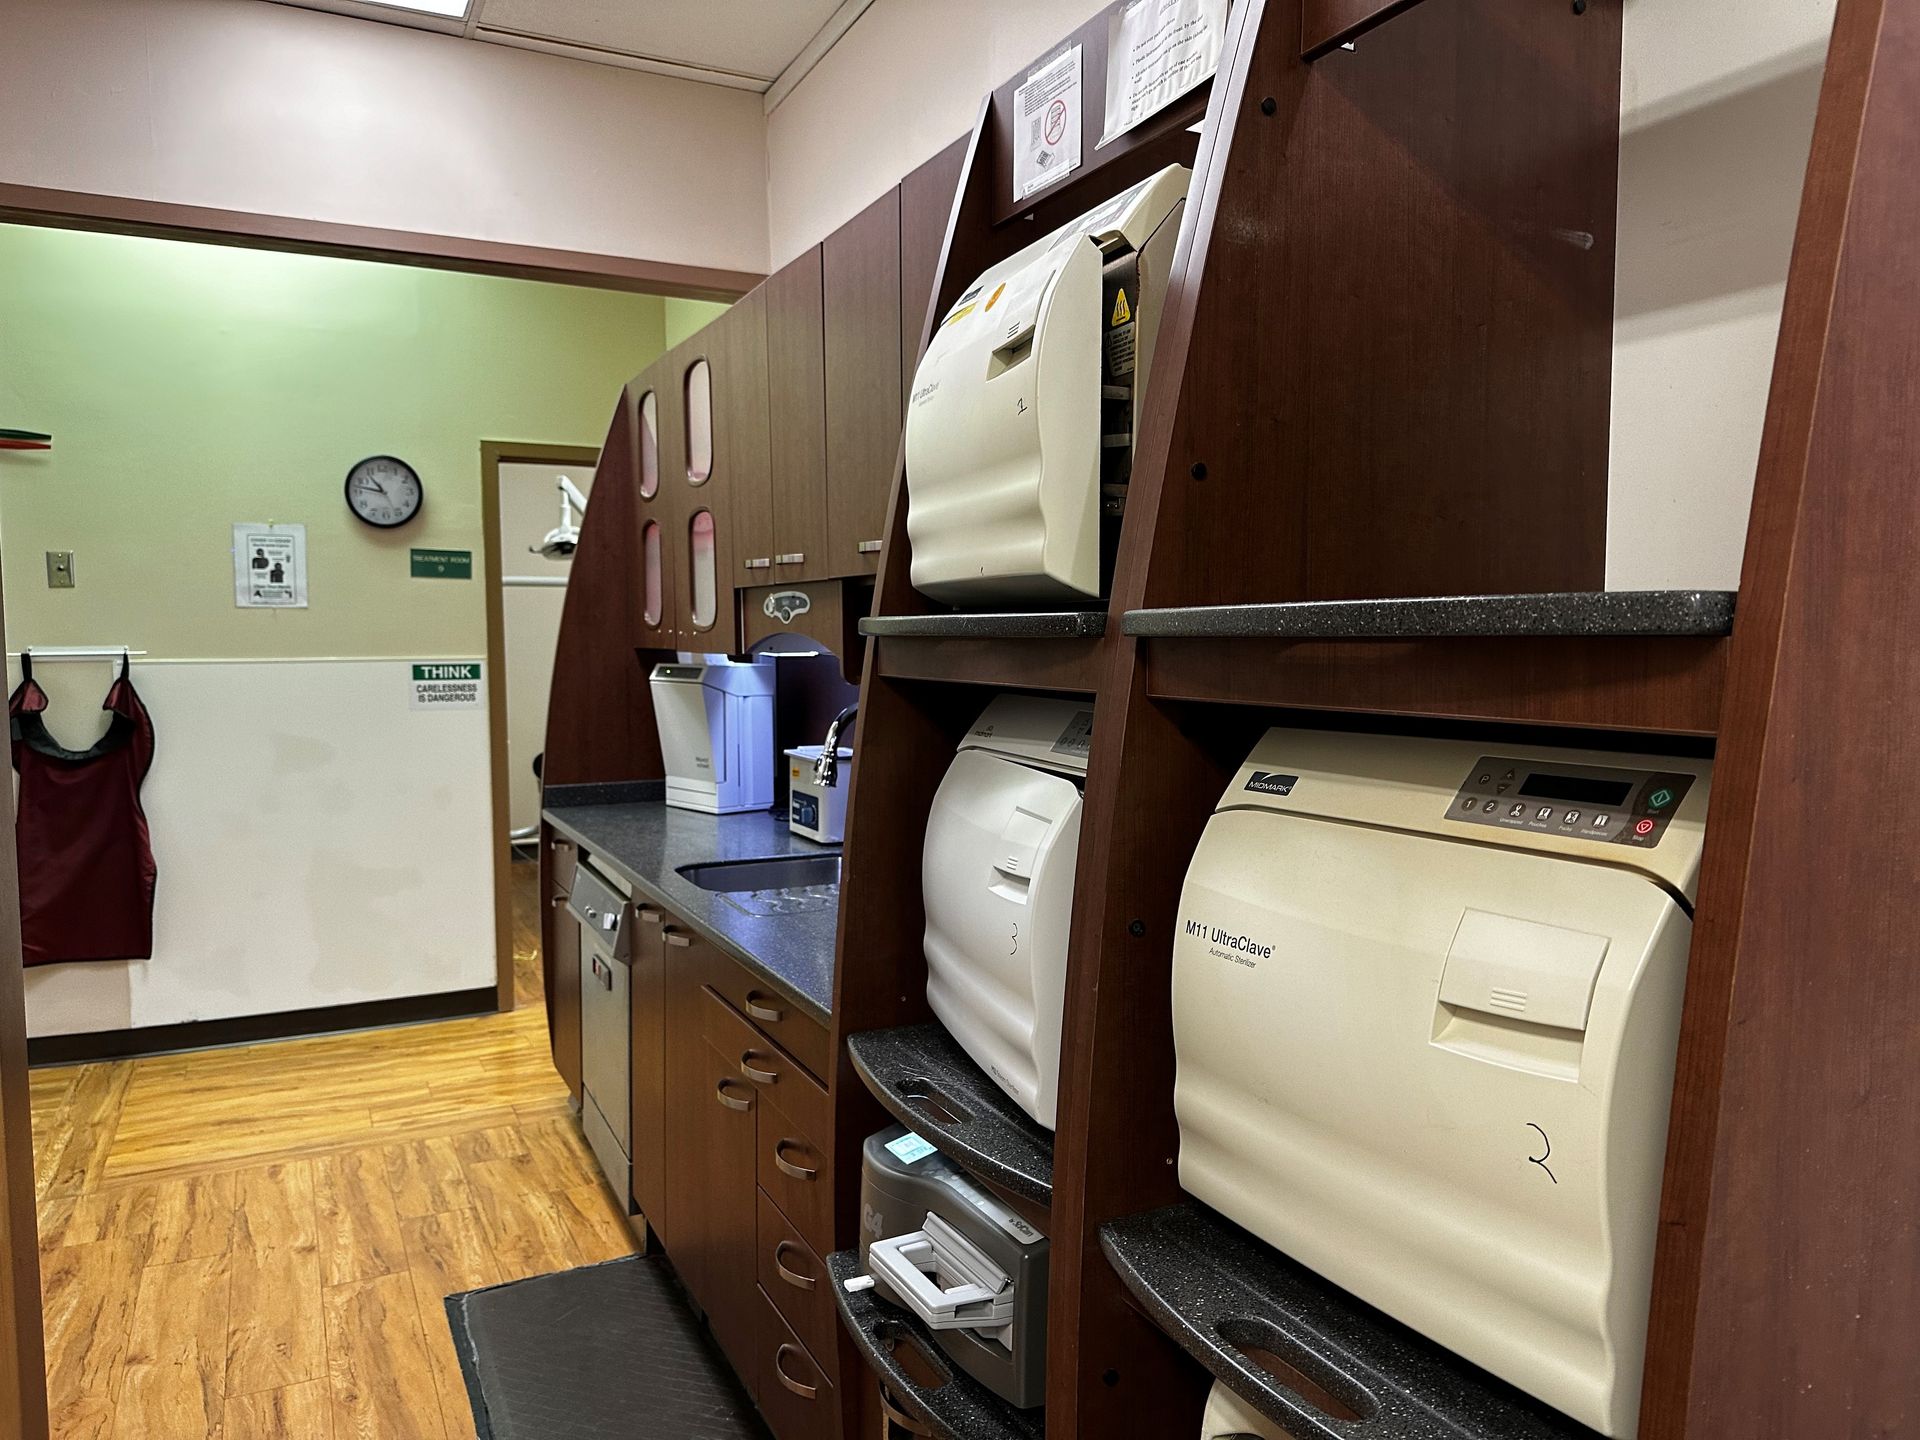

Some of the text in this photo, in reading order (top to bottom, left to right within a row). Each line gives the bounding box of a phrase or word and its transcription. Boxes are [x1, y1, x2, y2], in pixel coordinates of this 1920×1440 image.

[421, 666, 472, 679] THINK
[416, 684, 477, 693] CARELESSNESS
[418, 694, 476, 703] IS DANGEROUS
[1466, 800, 1495, 811] 1 2
[1186, 920, 1208, 939] M11
[1010, 922, 1018, 956] 3
[1209, 947, 1257, 969] Automatic Sterilizer
